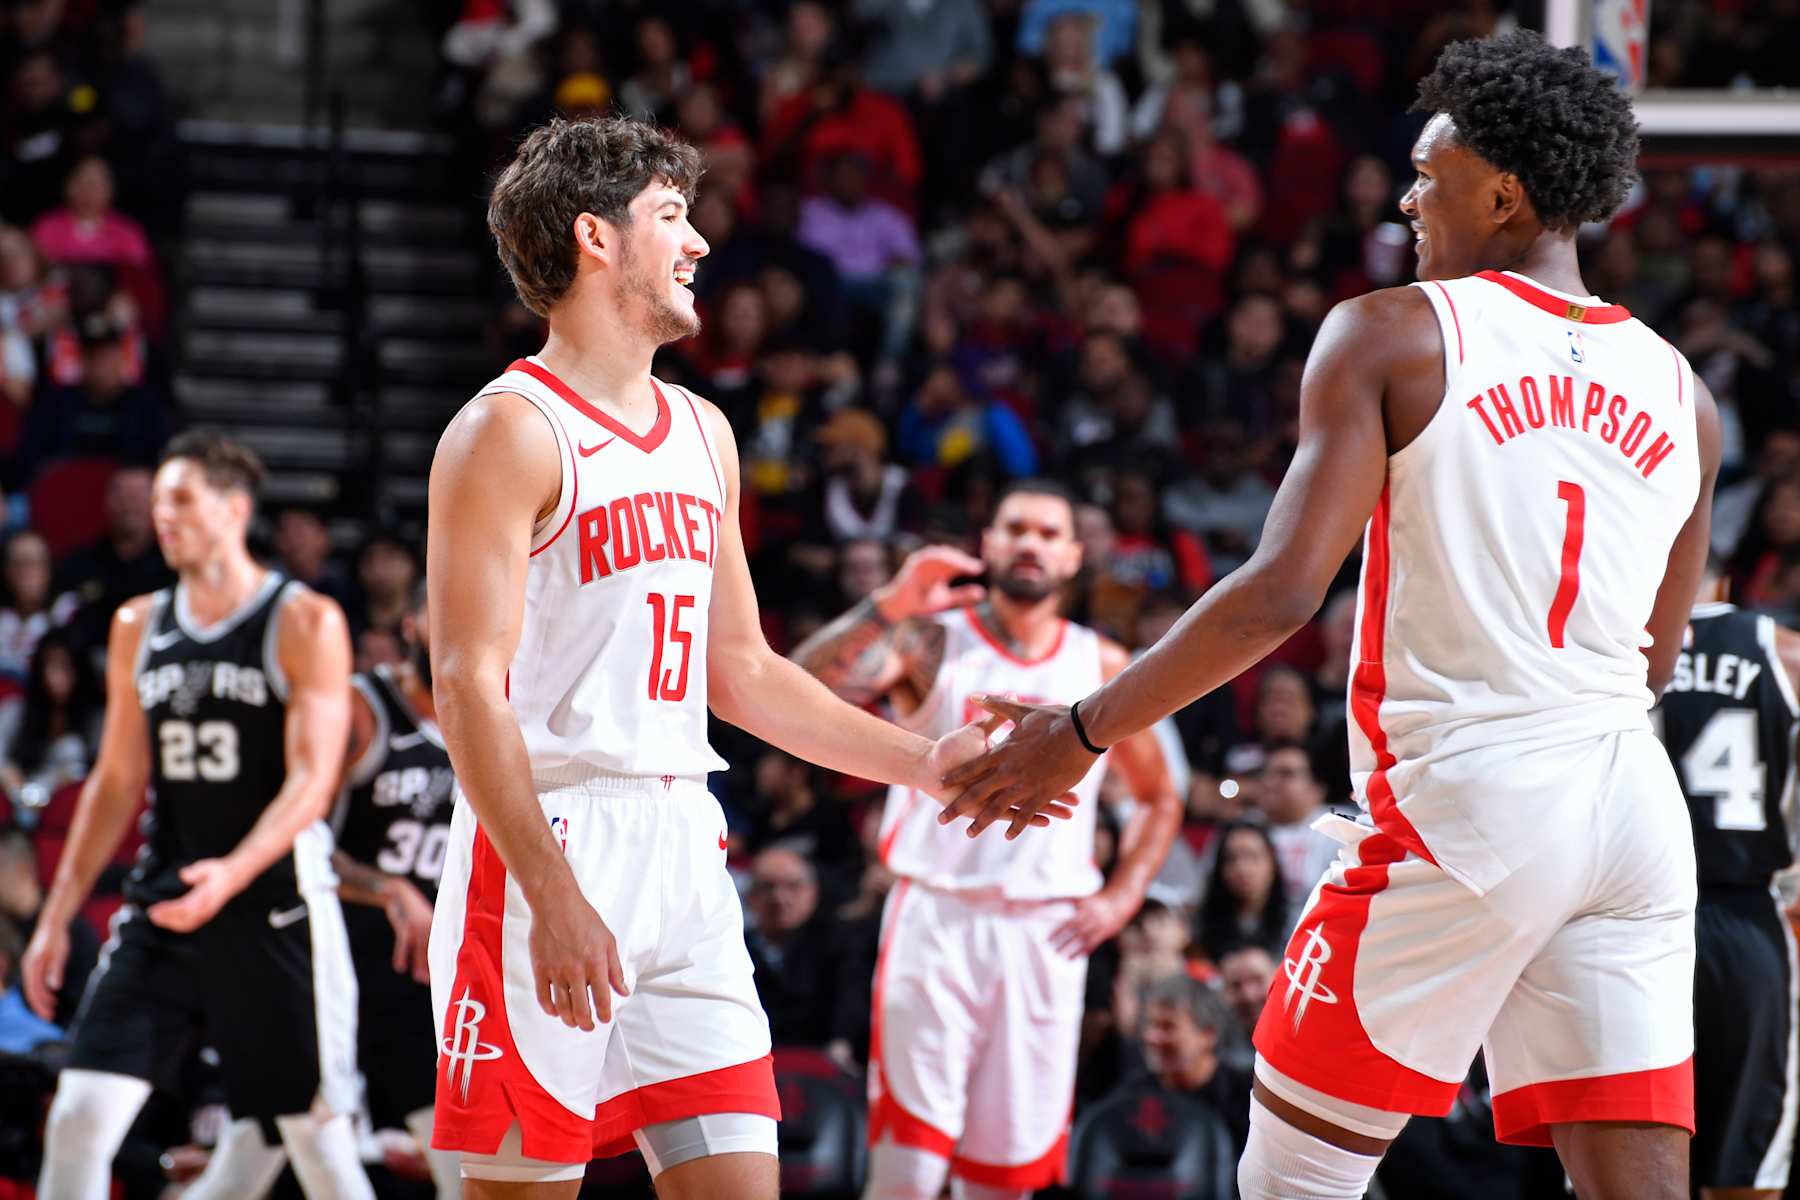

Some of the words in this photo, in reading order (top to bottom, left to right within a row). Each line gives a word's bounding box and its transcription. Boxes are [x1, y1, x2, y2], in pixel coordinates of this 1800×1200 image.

[1466, 374, 1676, 479] THOMPSON
[577, 491, 721, 586] ROCKET
[1547, 480, 1586, 648] 1
[646, 592, 695, 702] 15
[1664, 652, 1762, 700] SLEY
[159, 719, 239, 781] 23
[377, 820, 450, 879] 30
